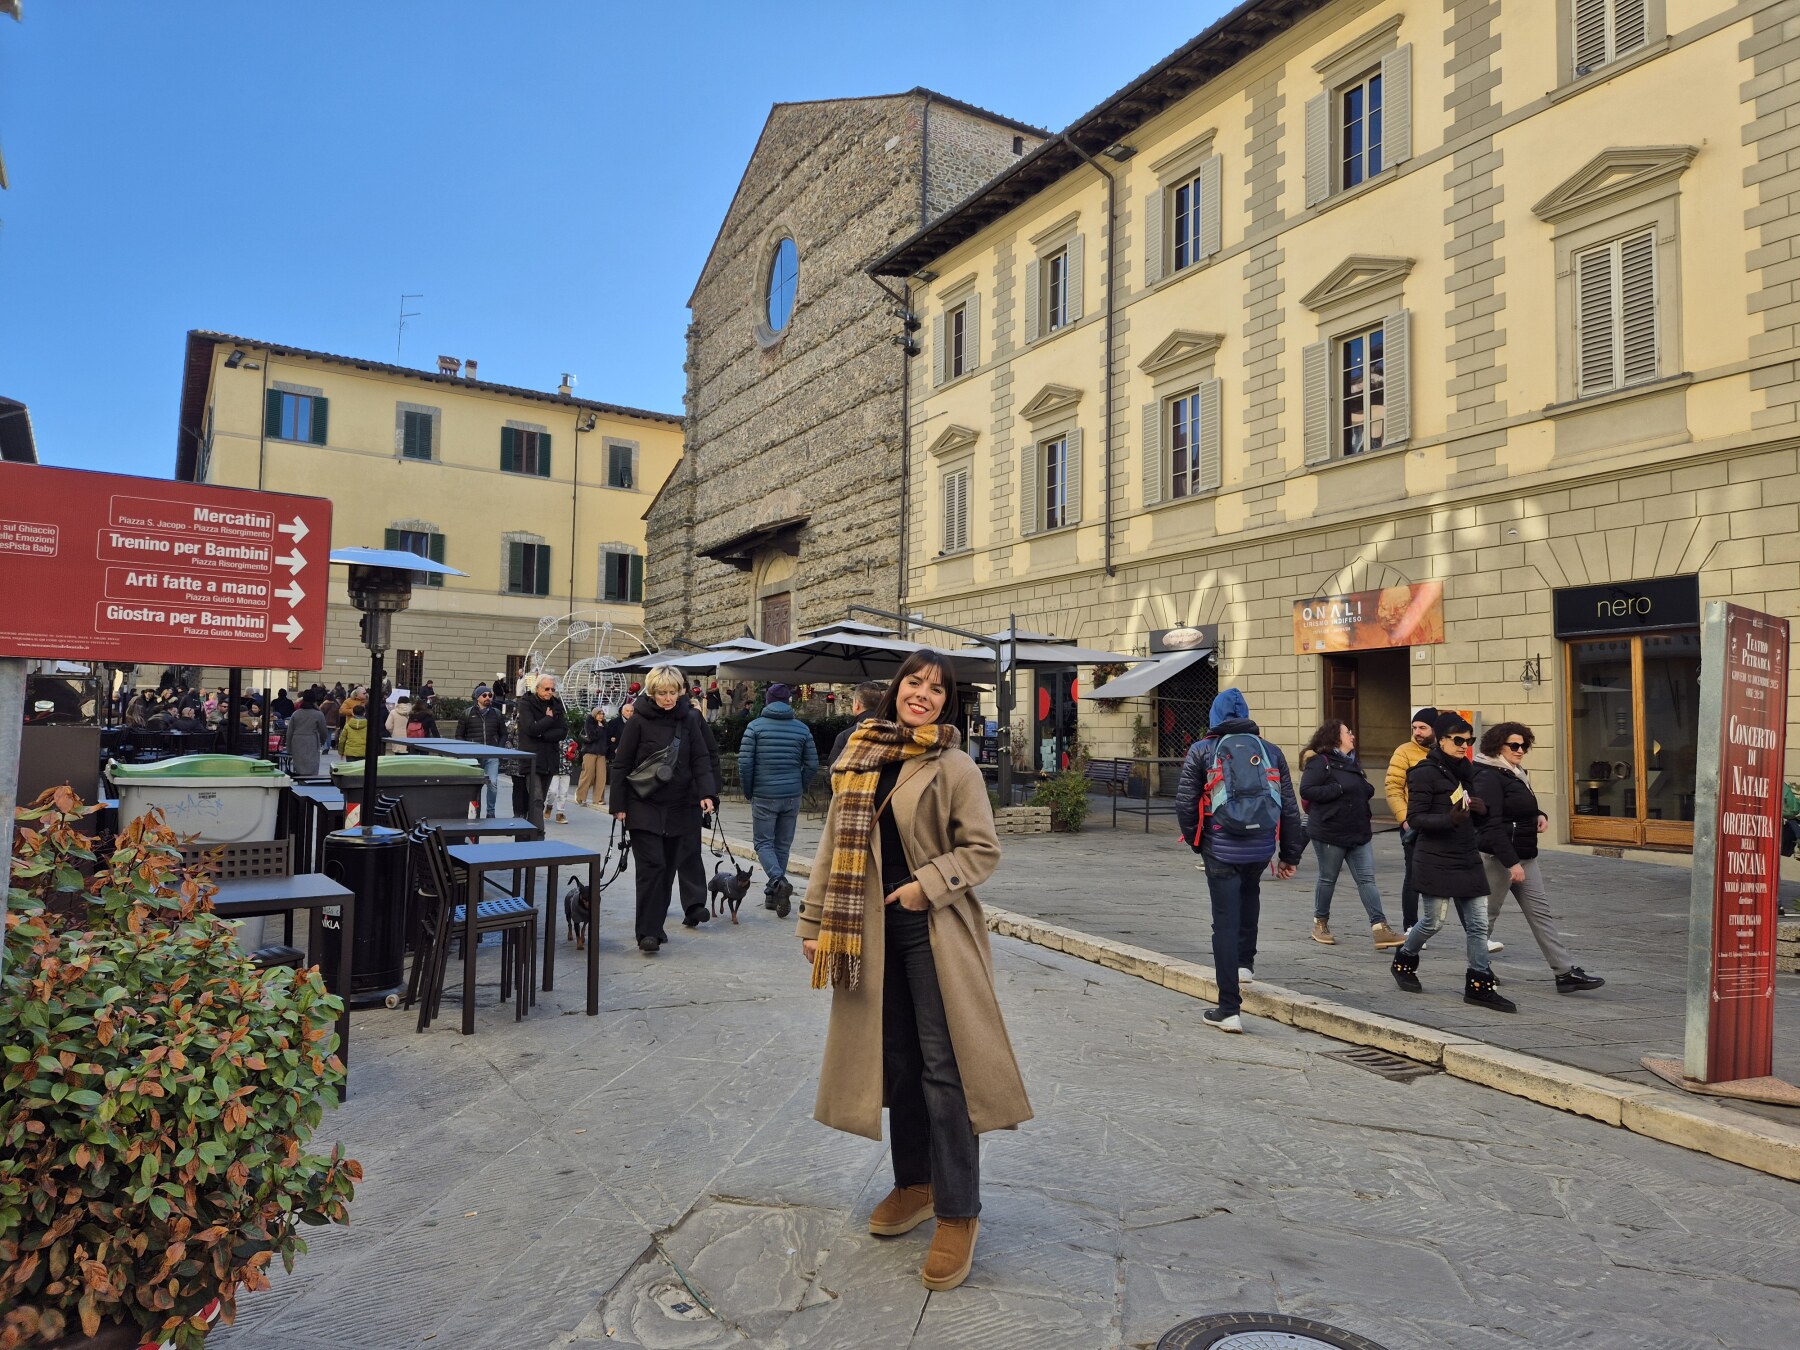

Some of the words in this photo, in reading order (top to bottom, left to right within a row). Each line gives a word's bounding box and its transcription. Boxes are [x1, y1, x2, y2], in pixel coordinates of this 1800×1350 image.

[119, 516, 144, 526] Piazza
[157, 520, 186, 530] Jacopo
[194, 524, 218, 533] Piazza
[220, 526, 270, 538] Risorgimento
[194, 508, 270, 528] Mercatini
[16, 534, 54, 544] Emozioni
[18, 524, 56, 535] Ghiaccio
[32, 544, 54, 554] Baby
[110, 534, 170, 552] Trenino
[174, 542, 201, 555] per
[205, 542, 269, 561] Bambini
[192, 558, 216, 567] Piazza
[218, 560, 268, 571] Risorgimento
[126, 572, 158, 587] Arti
[163, 575, 202, 591] fatte
[207, 581, 216, 592] a
[222, 582, 266, 596] mano
[185, 593, 210, 602] Piazza
[213, 594, 234, 604] Guido
[236, 596, 266, 606] Monaco
[1597, 597, 1651, 617] nero
[107, 606, 164, 622] Giostra
[170, 612, 197, 625] per
[201, 612, 264, 629] Bambini
[1303, 601, 1362, 621] ONALI
[1332, 616, 1362, 625] INDIFESO
[184, 627, 208, 636] Piazza
[211, 628, 232, 637] Guido
[234, 630, 264, 639] Monaco
[1746, 633, 1768, 653] TEATRO
[1742, 649, 1771, 671] PETRARCA
[1730, 715, 1776, 750] CONCERTO
[1748, 750, 1756, 765] DI
[1732, 766, 1769, 798] NATALE
[1723, 812, 1773, 838] ORCHESTRA
[1741, 838, 1754, 850] DELLA
[1728, 852, 1766, 875] TOSCANA
[1729, 914, 1745, 926] ETTORE
[1746, 915, 1761, 925] PAGANO
